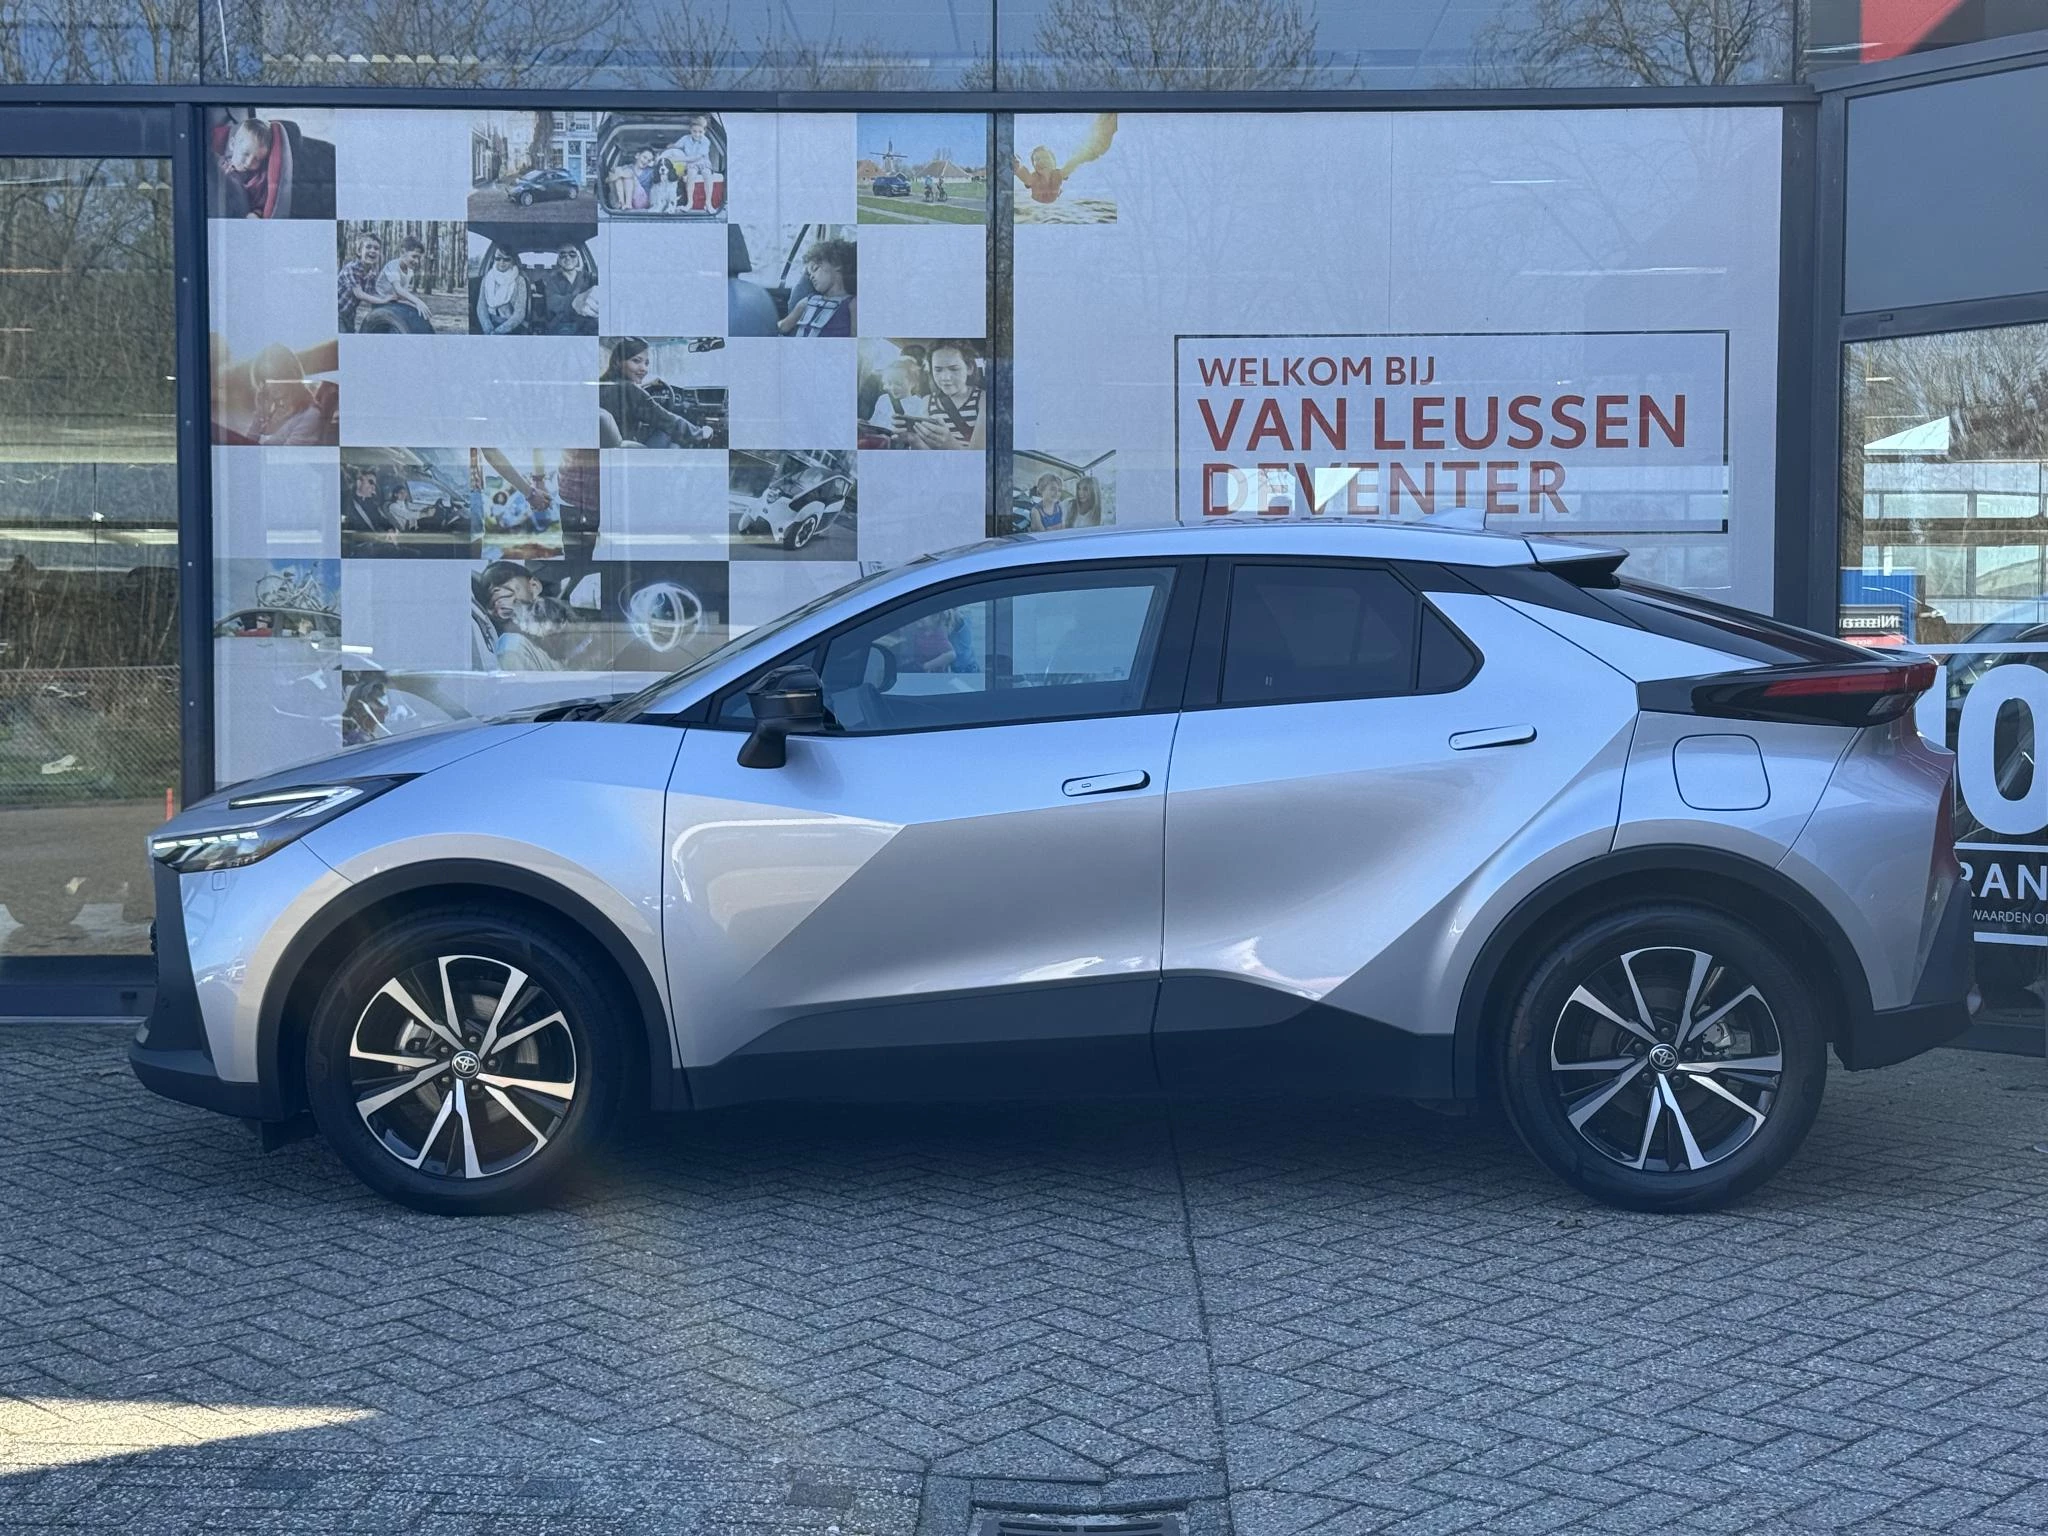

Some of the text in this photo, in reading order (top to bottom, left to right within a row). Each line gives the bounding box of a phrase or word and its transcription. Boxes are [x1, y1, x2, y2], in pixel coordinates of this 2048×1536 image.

[1198, 356, 1435, 386] WELKOM BIJ
[1197, 394, 1686, 451] VAN LEUSSEN
[1203, 461, 1570, 516] DEVENTER
